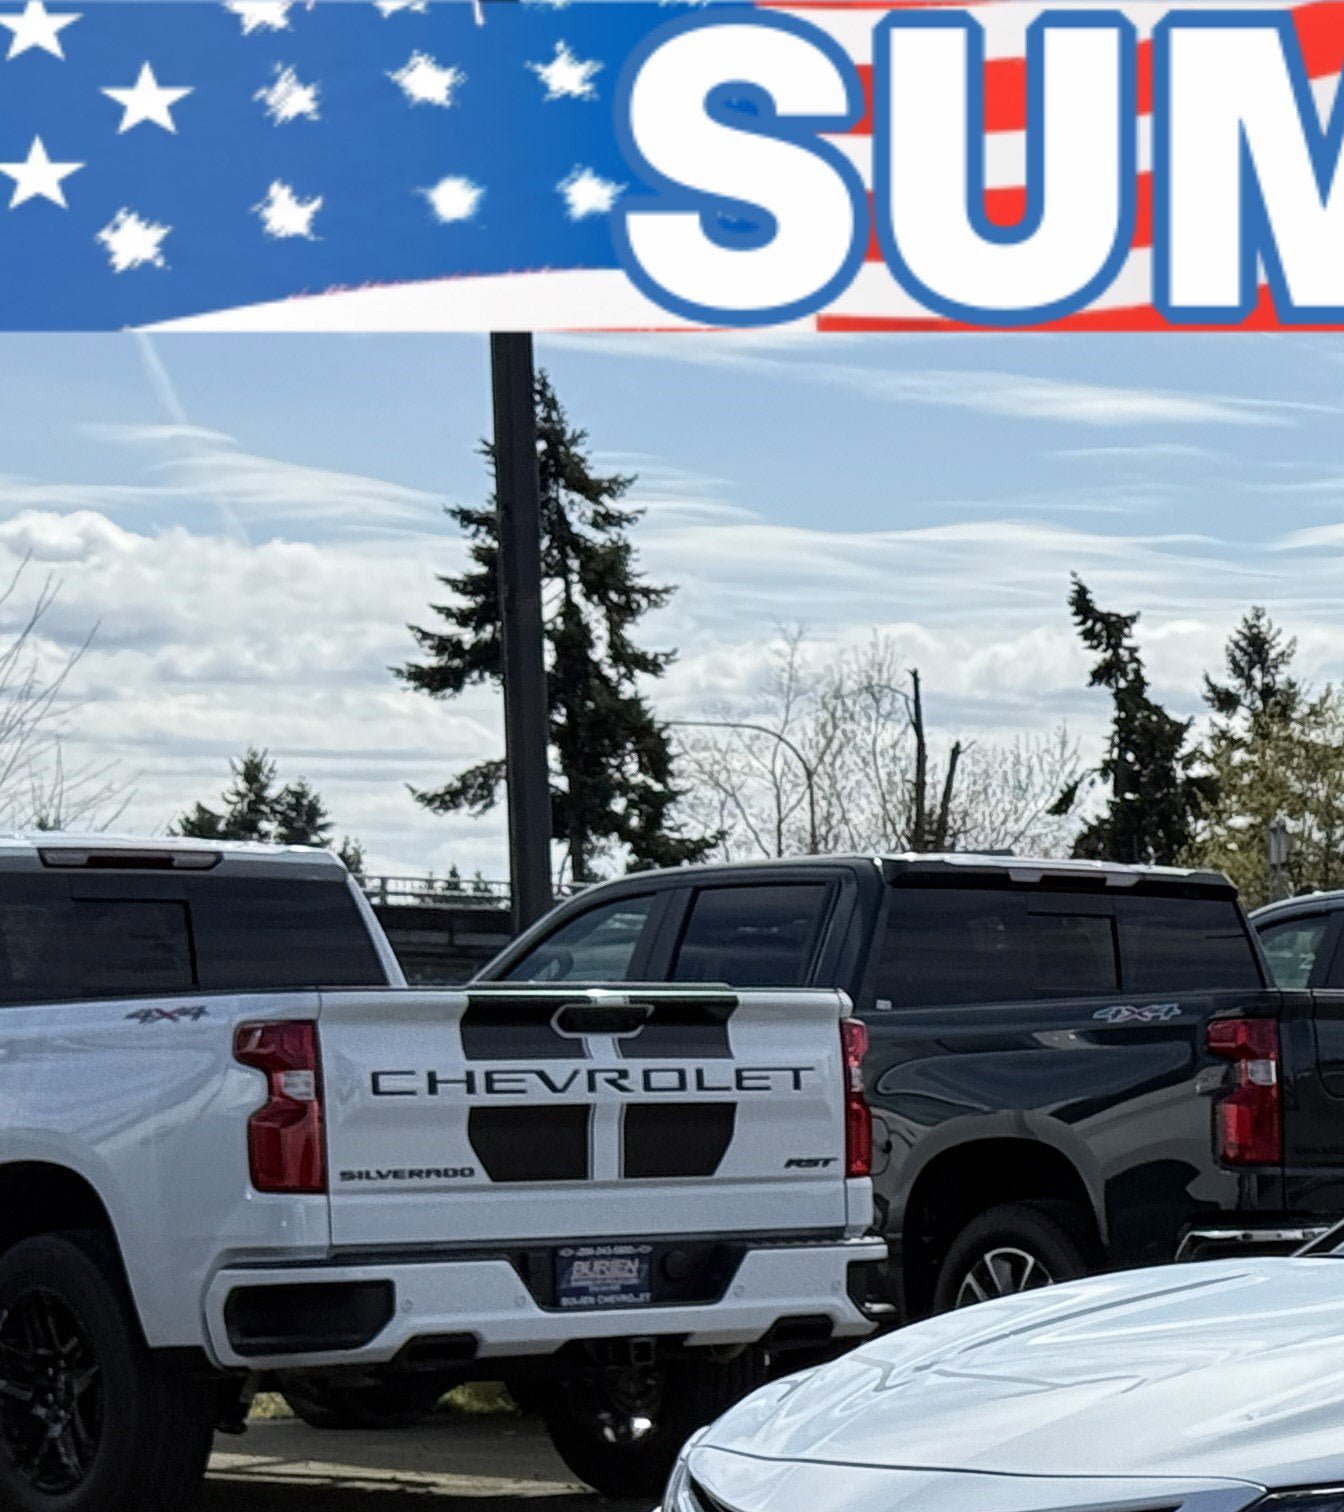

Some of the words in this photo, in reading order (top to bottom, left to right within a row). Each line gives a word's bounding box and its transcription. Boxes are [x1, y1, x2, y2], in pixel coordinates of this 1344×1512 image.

[370, 1067, 815, 1097] CHEVROLET
[783, 1157, 838, 1169] RST
[339, 1166, 475, 1181] SILVERADO
